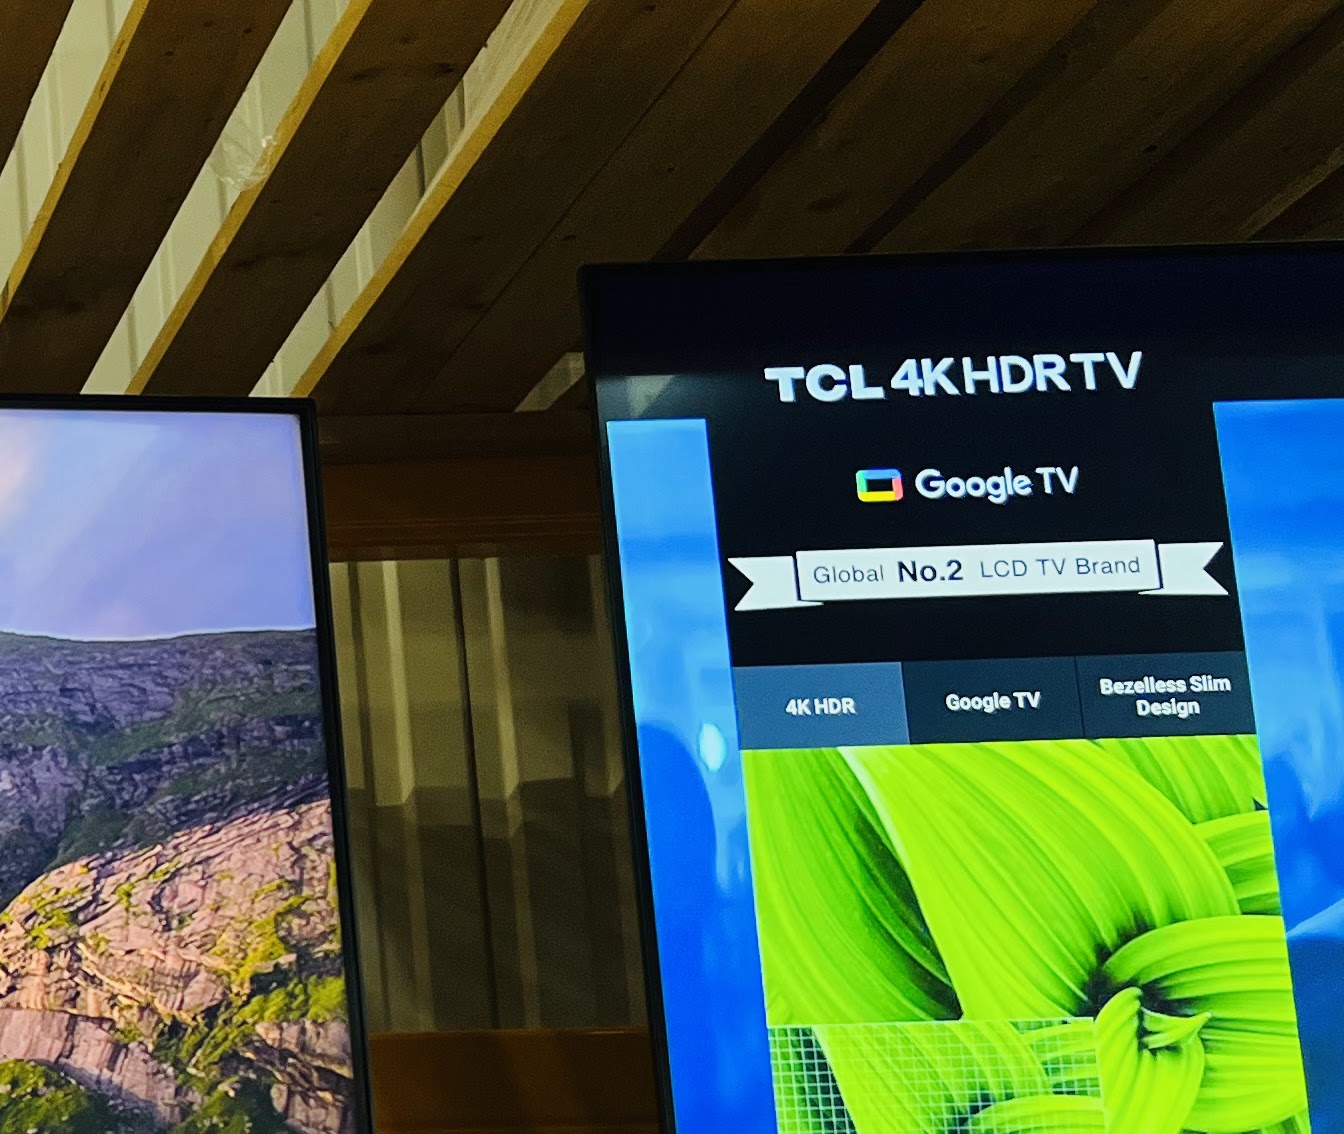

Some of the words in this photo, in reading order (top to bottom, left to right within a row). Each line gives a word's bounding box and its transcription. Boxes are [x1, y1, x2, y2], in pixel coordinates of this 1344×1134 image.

[764, 363, 886, 403] TCL
[915, 466, 1032, 505] Google
[1035, 466, 1079, 494] TV
[813, 564, 884, 584] Global
[897, 560, 964, 582] No.2
[979, 559, 1028, 578] LCD
[1036, 558, 1067, 576] TV
[1077, 556, 1141, 575] Brand
[1099, 675, 1187, 696] Bezelless
[1189, 673, 1231, 693] Slim
[785, 698, 812, 716] 4K
[814, 697, 856, 715] HDR
[945, 692, 1010, 714] Google
[1012, 691, 1041, 709] TV
[1136, 697, 1200, 720] Design
